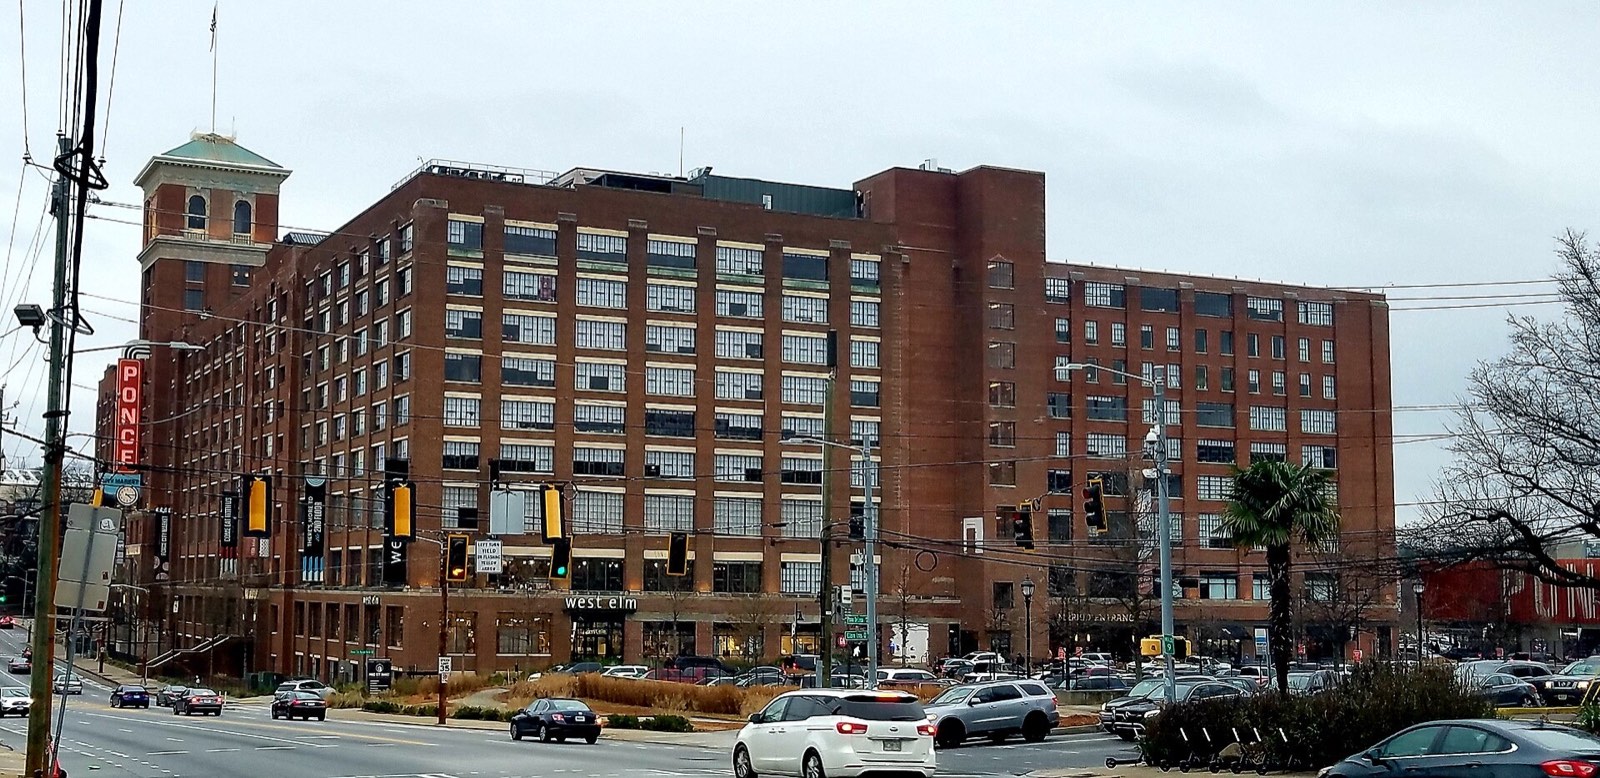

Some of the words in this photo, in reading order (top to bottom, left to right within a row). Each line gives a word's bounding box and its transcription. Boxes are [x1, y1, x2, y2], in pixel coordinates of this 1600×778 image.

[121, 365, 138, 465] PONCE
[224, 518, 232, 527] EAT
[565, 595, 602, 609] west
[608, 595, 637, 609] elm
[1094, 613, 1135, 622] ENTRANC
[1166, 643, 1172, 651] 9
[440, 664, 450, 672] 35
